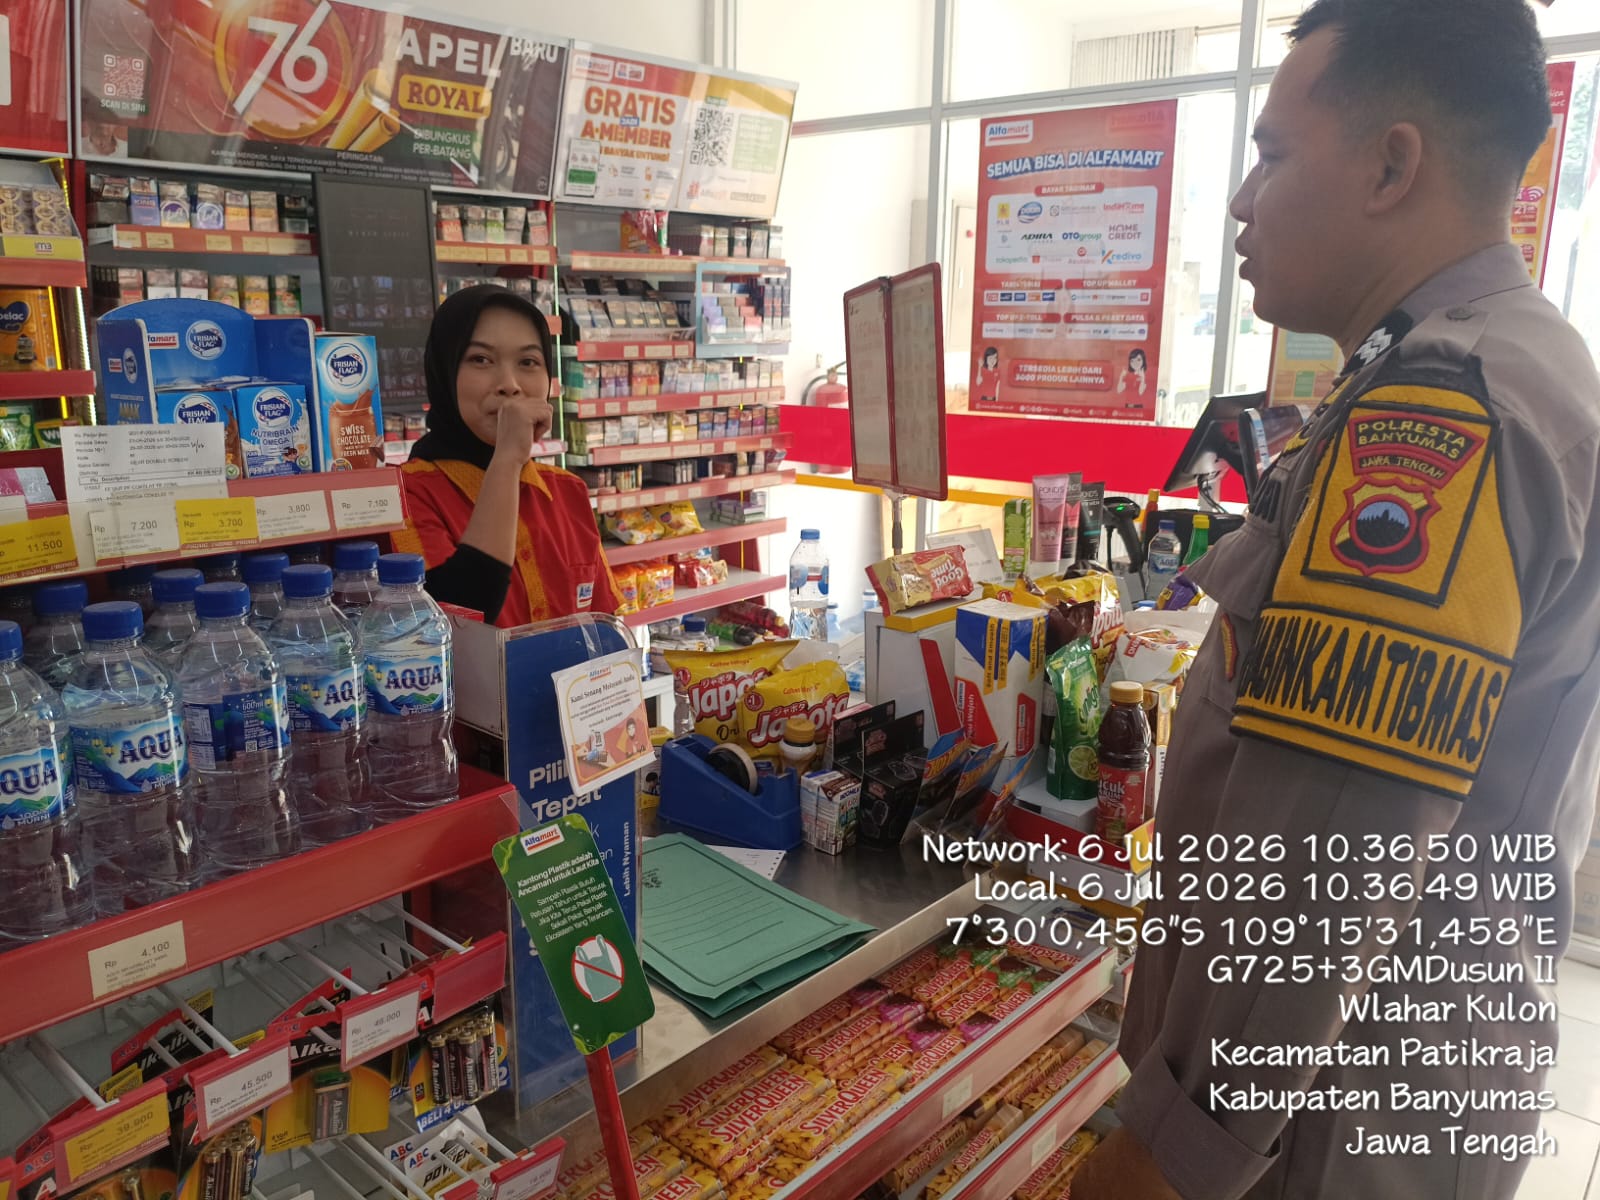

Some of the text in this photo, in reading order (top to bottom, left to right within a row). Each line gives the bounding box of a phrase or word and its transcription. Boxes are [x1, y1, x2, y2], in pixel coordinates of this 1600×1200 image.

[233, 1, 332, 115] 76
[509, 36, 561, 64] BARU
[101, 99, 146, 112] SCAN DI SINI
[406, 80, 485, 114] ROYAL
[584, 86, 676, 126] GRATIS
[414, 128, 471, 146] DIBUNGKUS
[988, 125, 1030, 137] Alfamart
[412, 143, 471, 159] PER-BATANG
[986, 150, 1165, 178] SEMUA BISA DI ALFAMART
[1061, 231, 1102, 242] OTOgroup
[1108, 231, 1142, 242] CREDIT
[1108, 224, 1138, 233] HOME
[193, 334, 219, 342] FRISIAN
[333, 360, 358, 368] FRISIAN
[338, 367, 355, 375] FLAG
[260, 403, 285, 411] FRISIAN
[251, 426, 300, 438] NUTRIBRAIN
[336, 435, 372, 446] CHOCOLATE
[340, 424, 365, 435] SWISS
[1358, 419, 1466, 448] POLRESTA
[262, 438, 290, 446] OMEGA
[1358, 431, 1460, 460] BANYUMAS
[1361, 455, 1446, 480] JAWA TENGAH
[1039, 486, 1065, 494] POND'S
[288, 503, 311, 514] 3.800
[341, 502, 352, 510] Rp
[131, 519, 158, 531] 7.200
[183, 518, 243, 528] Rp 3.700
[27, 539, 63, 553] 11.500
[930, 558, 956, 578] Time
[934, 567, 965, 591] Good
[384, 665, 443, 692] AQUA
[323, 679, 366, 707] AQU
[118, 725, 184, 765] AQUA
[0, 759, 58, 796] QUA
[531, 786, 602, 822] Tepat
[524, 828, 558, 847] Alfamart
[517, 851, 593, 889] Kantong Plastik adalah
[622, 821, 631, 896] Lebih Nyaman
[518, 859, 600, 898] Ancaman untuk Laut Kita
[537, 892, 561, 906] Sampah
[141, 941, 170, 957] 4.100
[914, 959, 971, 998] SILVERQUEEN
[937, 981, 996, 1024] SILVERQUEEN
[993, 990, 1030, 1020] ERQUEEN
[781, 1001, 850, 1043] SILVERQUEEN
[806, 1014, 879, 1062] SILVERQUEEN
[465, 1056, 475, 1098] Alkaline
[489, 1046, 499, 1090] Alkaline
[240, 1071, 273, 1092] 45.500
[432, 1059, 441, 1102] Alkaline
[668, 1050, 762, 1115] SILVERQUEEN
[711, 1074, 807, 1144] SILVERQUEEN
[800, 1067, 887, 1137] SILVERQUEEN
[421, 1109, 443, 1128] BELI
[390, 1142, 414, 1160] ABC
[408, 1147, 430, 1169] ABC
[951, 1128, 994, 1170] SILVERQUEEN
